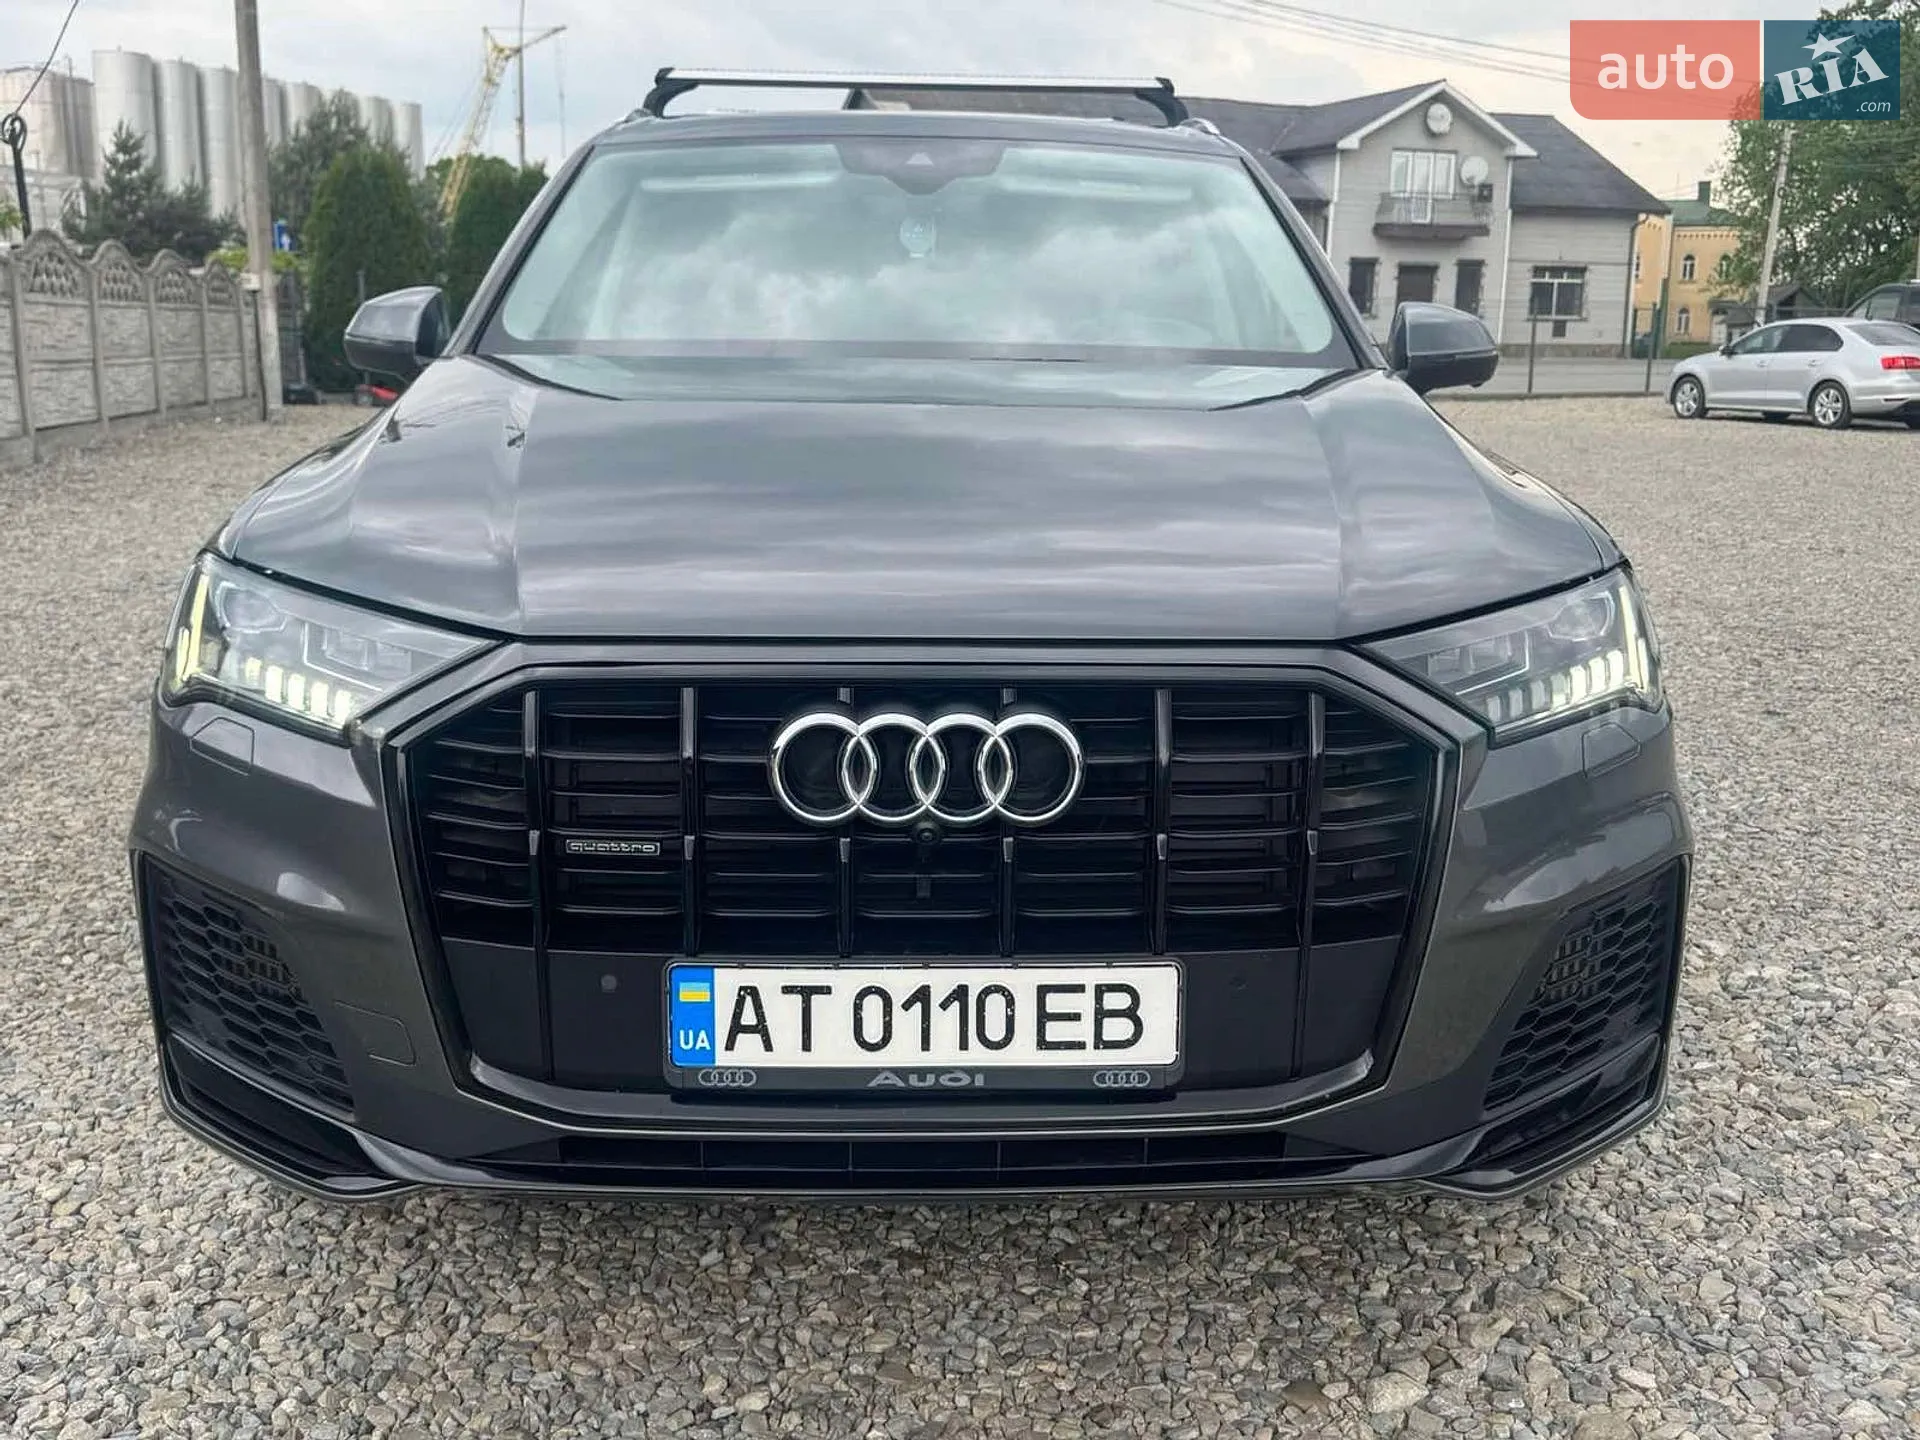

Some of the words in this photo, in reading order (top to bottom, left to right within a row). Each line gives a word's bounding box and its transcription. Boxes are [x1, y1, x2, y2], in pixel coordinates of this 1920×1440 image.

[570, 842, 656, 853] quattro
[724, 984, 833, 1053] AT
[853, 984, 1016, 1052] 0110
[1036, 983, 1144, 1051] EB
[679, 1029, 711, 1051] UA
